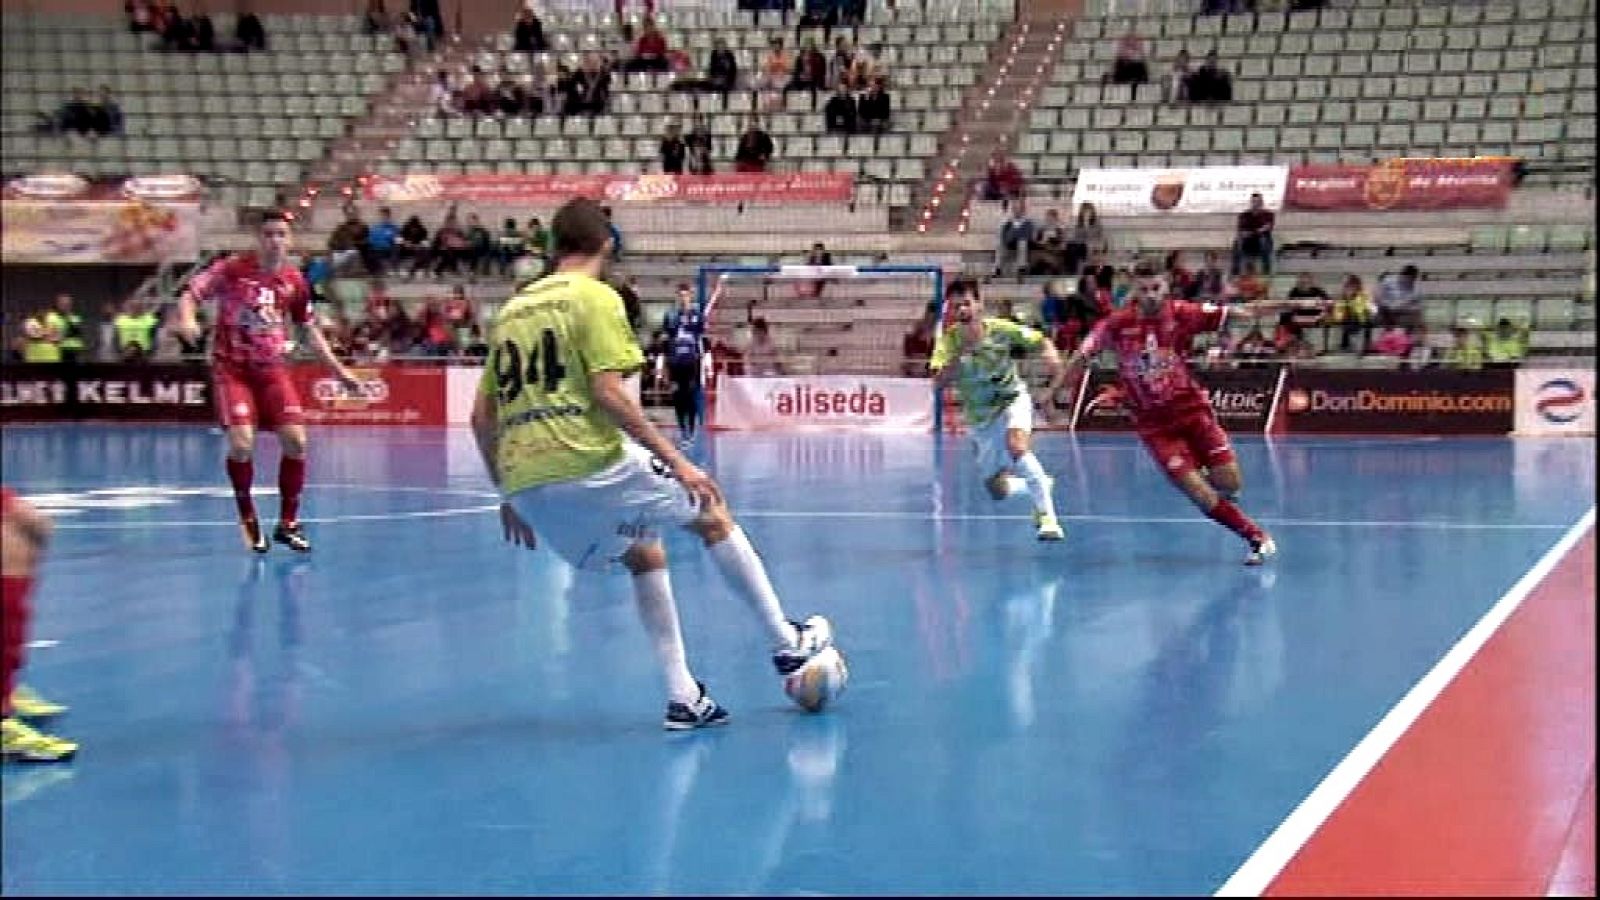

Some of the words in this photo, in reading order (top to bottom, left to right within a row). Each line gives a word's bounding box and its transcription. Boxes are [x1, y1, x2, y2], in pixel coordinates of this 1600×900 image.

[495, 327, 566, 405] 94
[76, 380, 207, 404] KELME
[776, 385, 887, 415] aliseda
[1311, 390, 1512, 412] DonDominio.com
